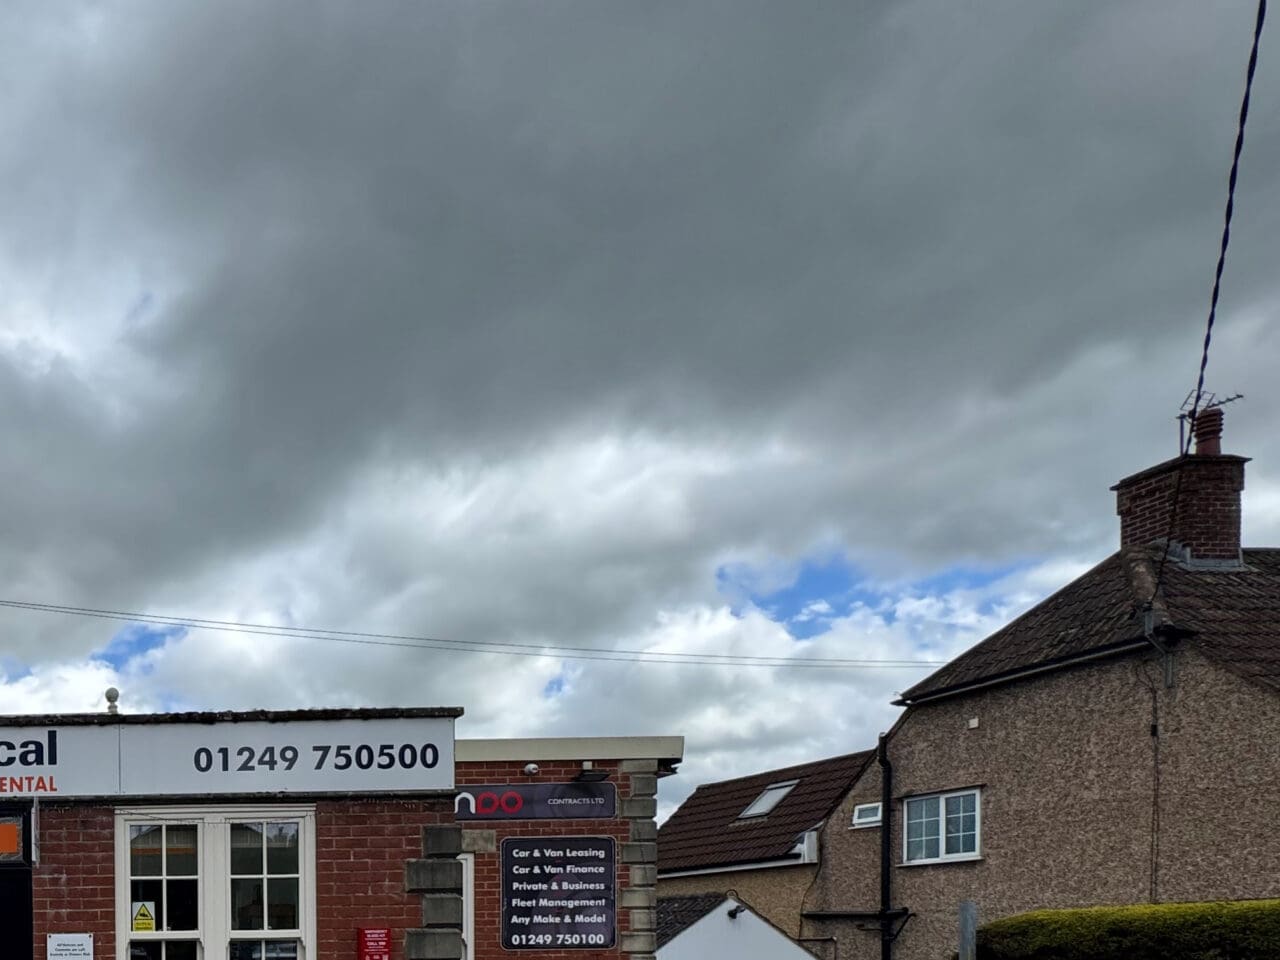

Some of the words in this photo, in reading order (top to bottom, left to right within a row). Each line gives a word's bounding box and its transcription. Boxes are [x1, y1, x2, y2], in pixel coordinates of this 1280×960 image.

[193, 746, 299, 772] 01249
[312, 743, 439, 770] 750500
[547, 797, 590, 806] CONTRACTS
[591, 797, 606, 805] LTD
[512, 849, 530, 858] Car
[533, 849, 541, 857] &
[544, 849, 564, 858] Van
[566, 848, 606, 859] Leasing
[512, 865, 530, 875] Car
[533, 865, 541, 874] &
[544, 865, 564, 874] Van
[566, 865, 606, 874] Finance
[512, 882, 548, 891] Private
[551, 882, 559, 890] &
[562, 882, 606, 890] Business
[511, 898, 537, 907] Fleet
[538, 898, 606, 909] Management
[511, 915, 531, 925] Any
[532, 915, 561, 924] Make
[564, 915, 572, 923] &
[574, 914, 606, 923] Model
[511, 934, 553, 945] 01249
[556, 934, 605, 945] 750100
